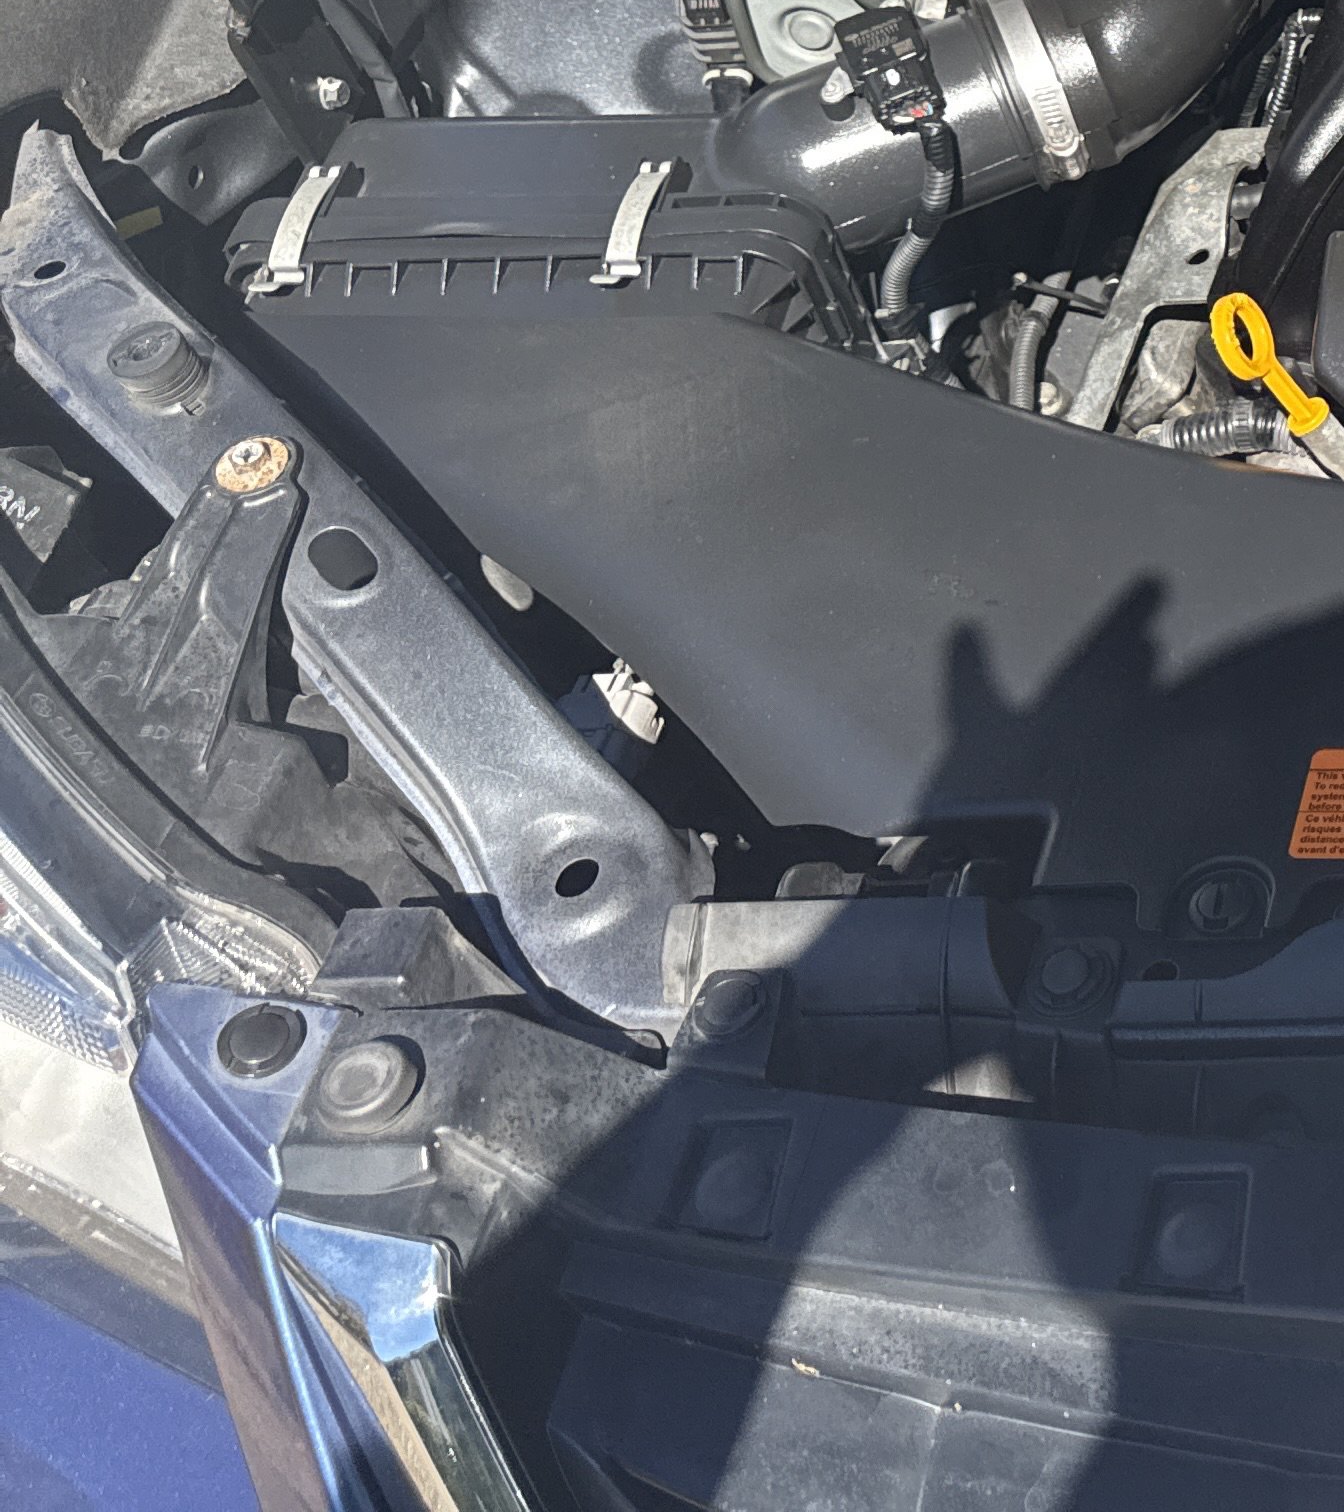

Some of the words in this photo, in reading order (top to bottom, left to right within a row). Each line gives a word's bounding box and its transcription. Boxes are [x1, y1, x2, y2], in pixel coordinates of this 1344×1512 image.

[1314, 782, 1325, 790] To
[1308, 803, 1342, 811] before
[1305, 815, 1319, 823] Ce
[1302, 826, 1342, 835] risques
[1300, 836, 1344, 844] distance
